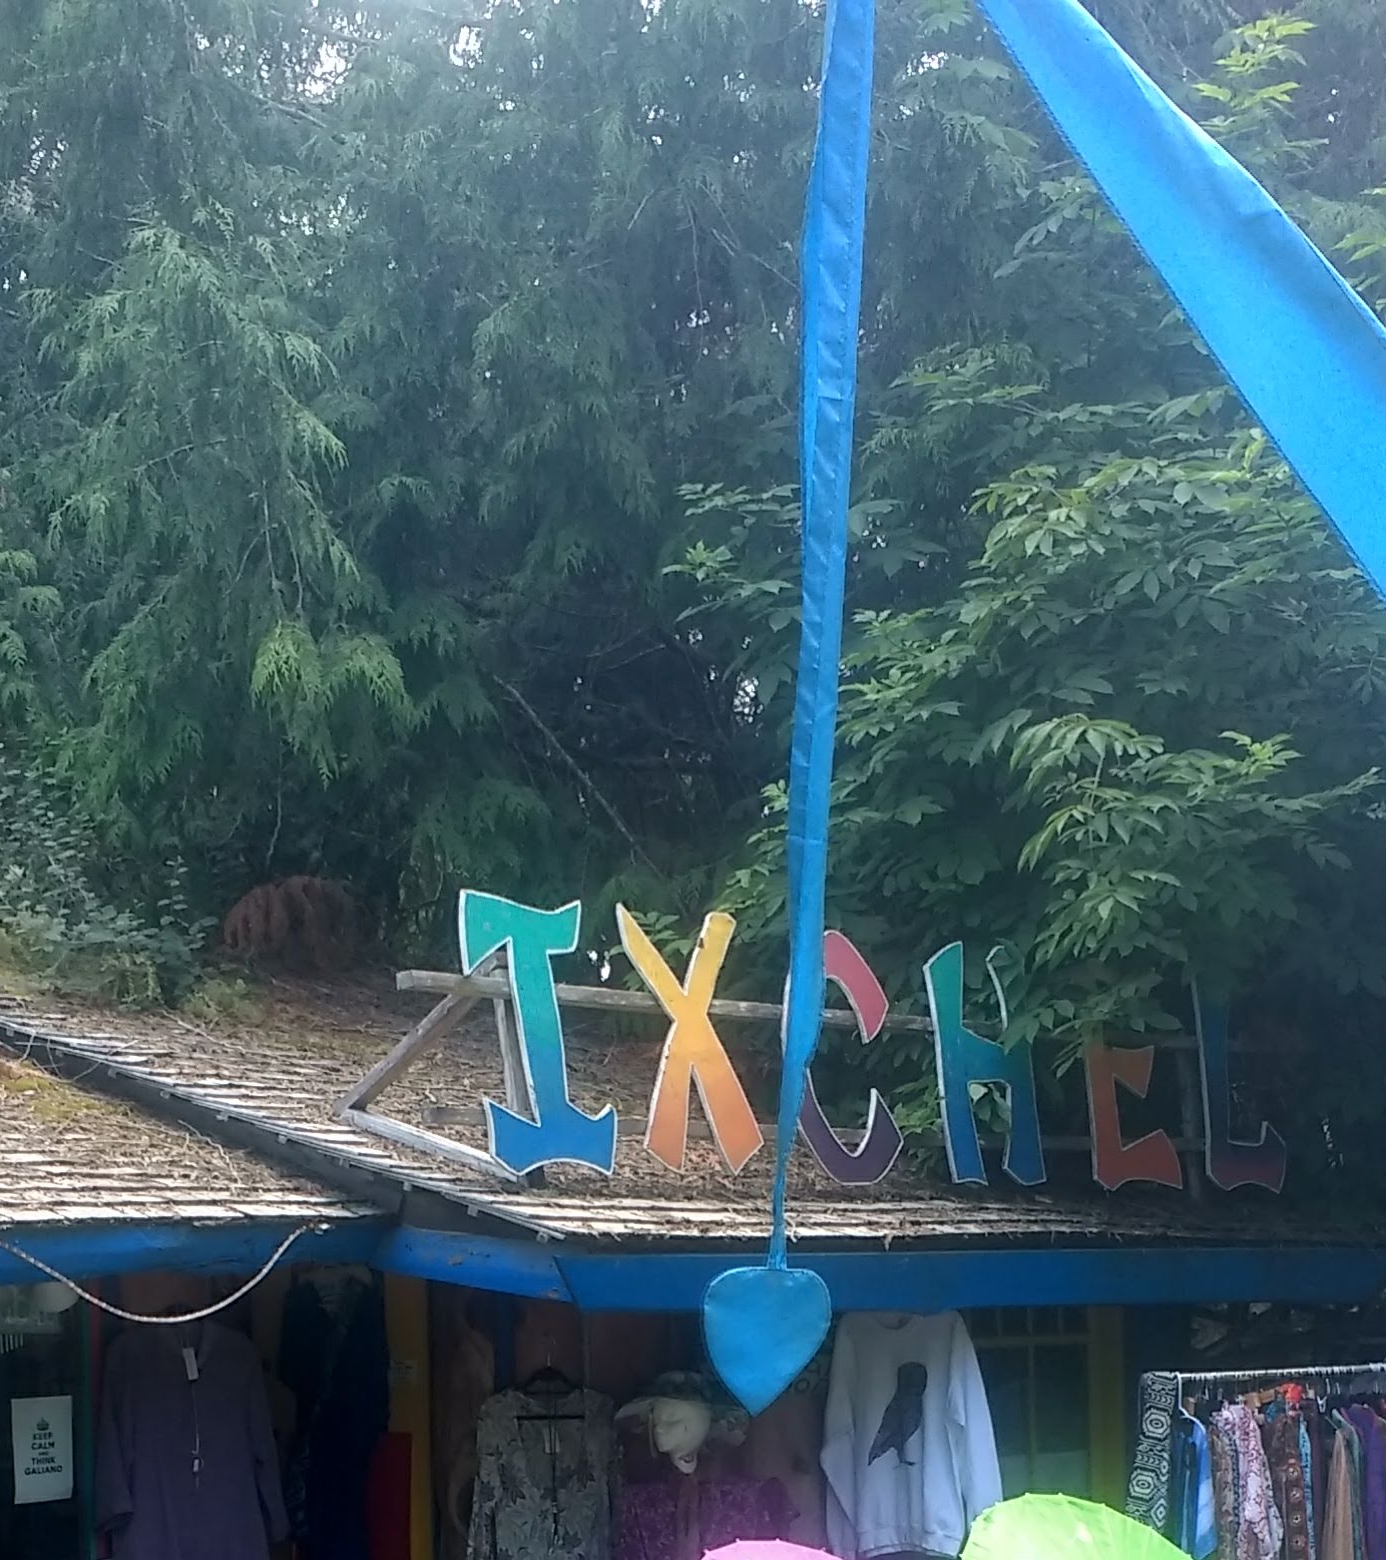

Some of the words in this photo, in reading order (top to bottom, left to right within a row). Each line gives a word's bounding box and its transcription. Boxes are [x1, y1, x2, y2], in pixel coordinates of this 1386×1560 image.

[458, 889, 1287, 1193] IXCHEL
[33, 1431, 53, 1441] KEEP
[31, 1441, 55, 1450] CALM
[31, 1456, 56, 1465] THINK
[24, 1465, 63, 1476] GALIANO
